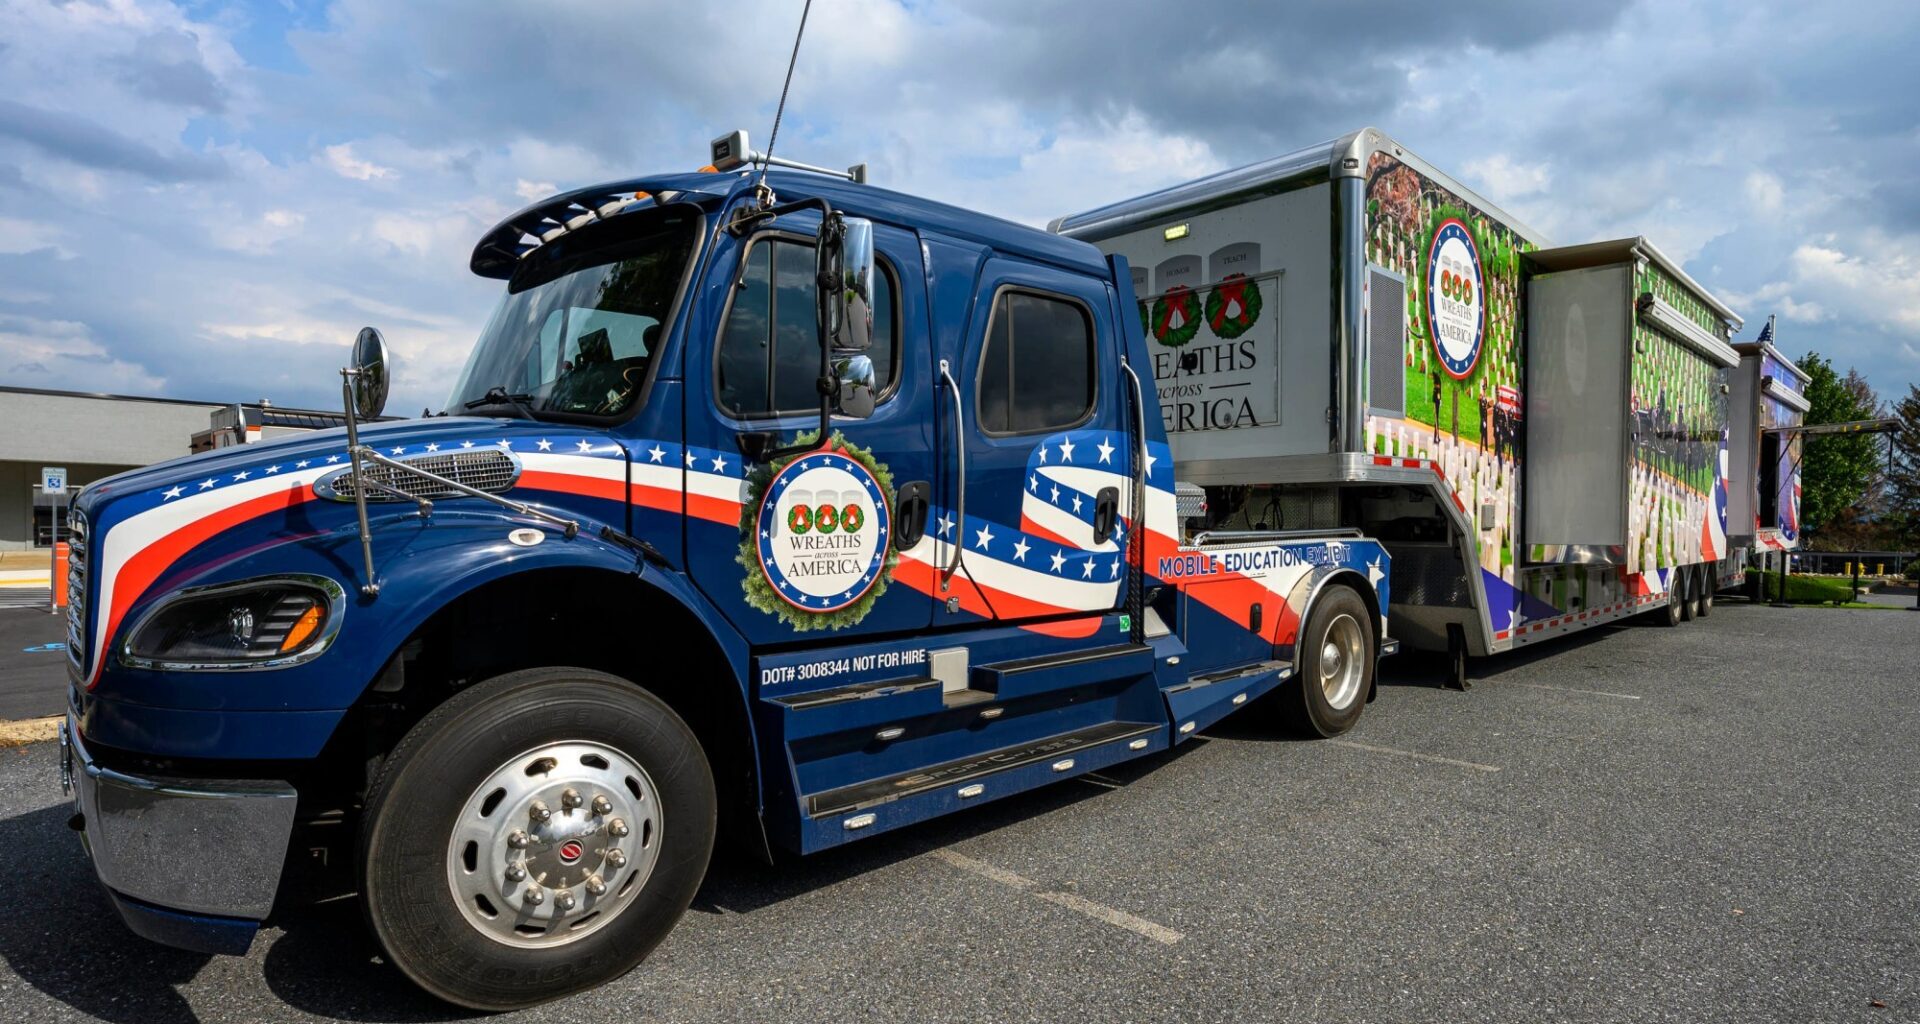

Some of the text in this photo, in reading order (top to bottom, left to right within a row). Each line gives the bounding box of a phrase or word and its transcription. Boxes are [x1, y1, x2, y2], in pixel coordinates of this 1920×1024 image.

[1152, 340, 1256, 380] EATHS
[1160, 396, 1260, 433] ERICA
[789, 534, 862, 550] WREATHS
[787, 559, 862, 577] AMERICA
[1159, 545, 1351, 579] MOBILE EDUCATION EXHIBIT
[761, 649, 926, 685] DOT# 3008344 NOT FOR HIRE
